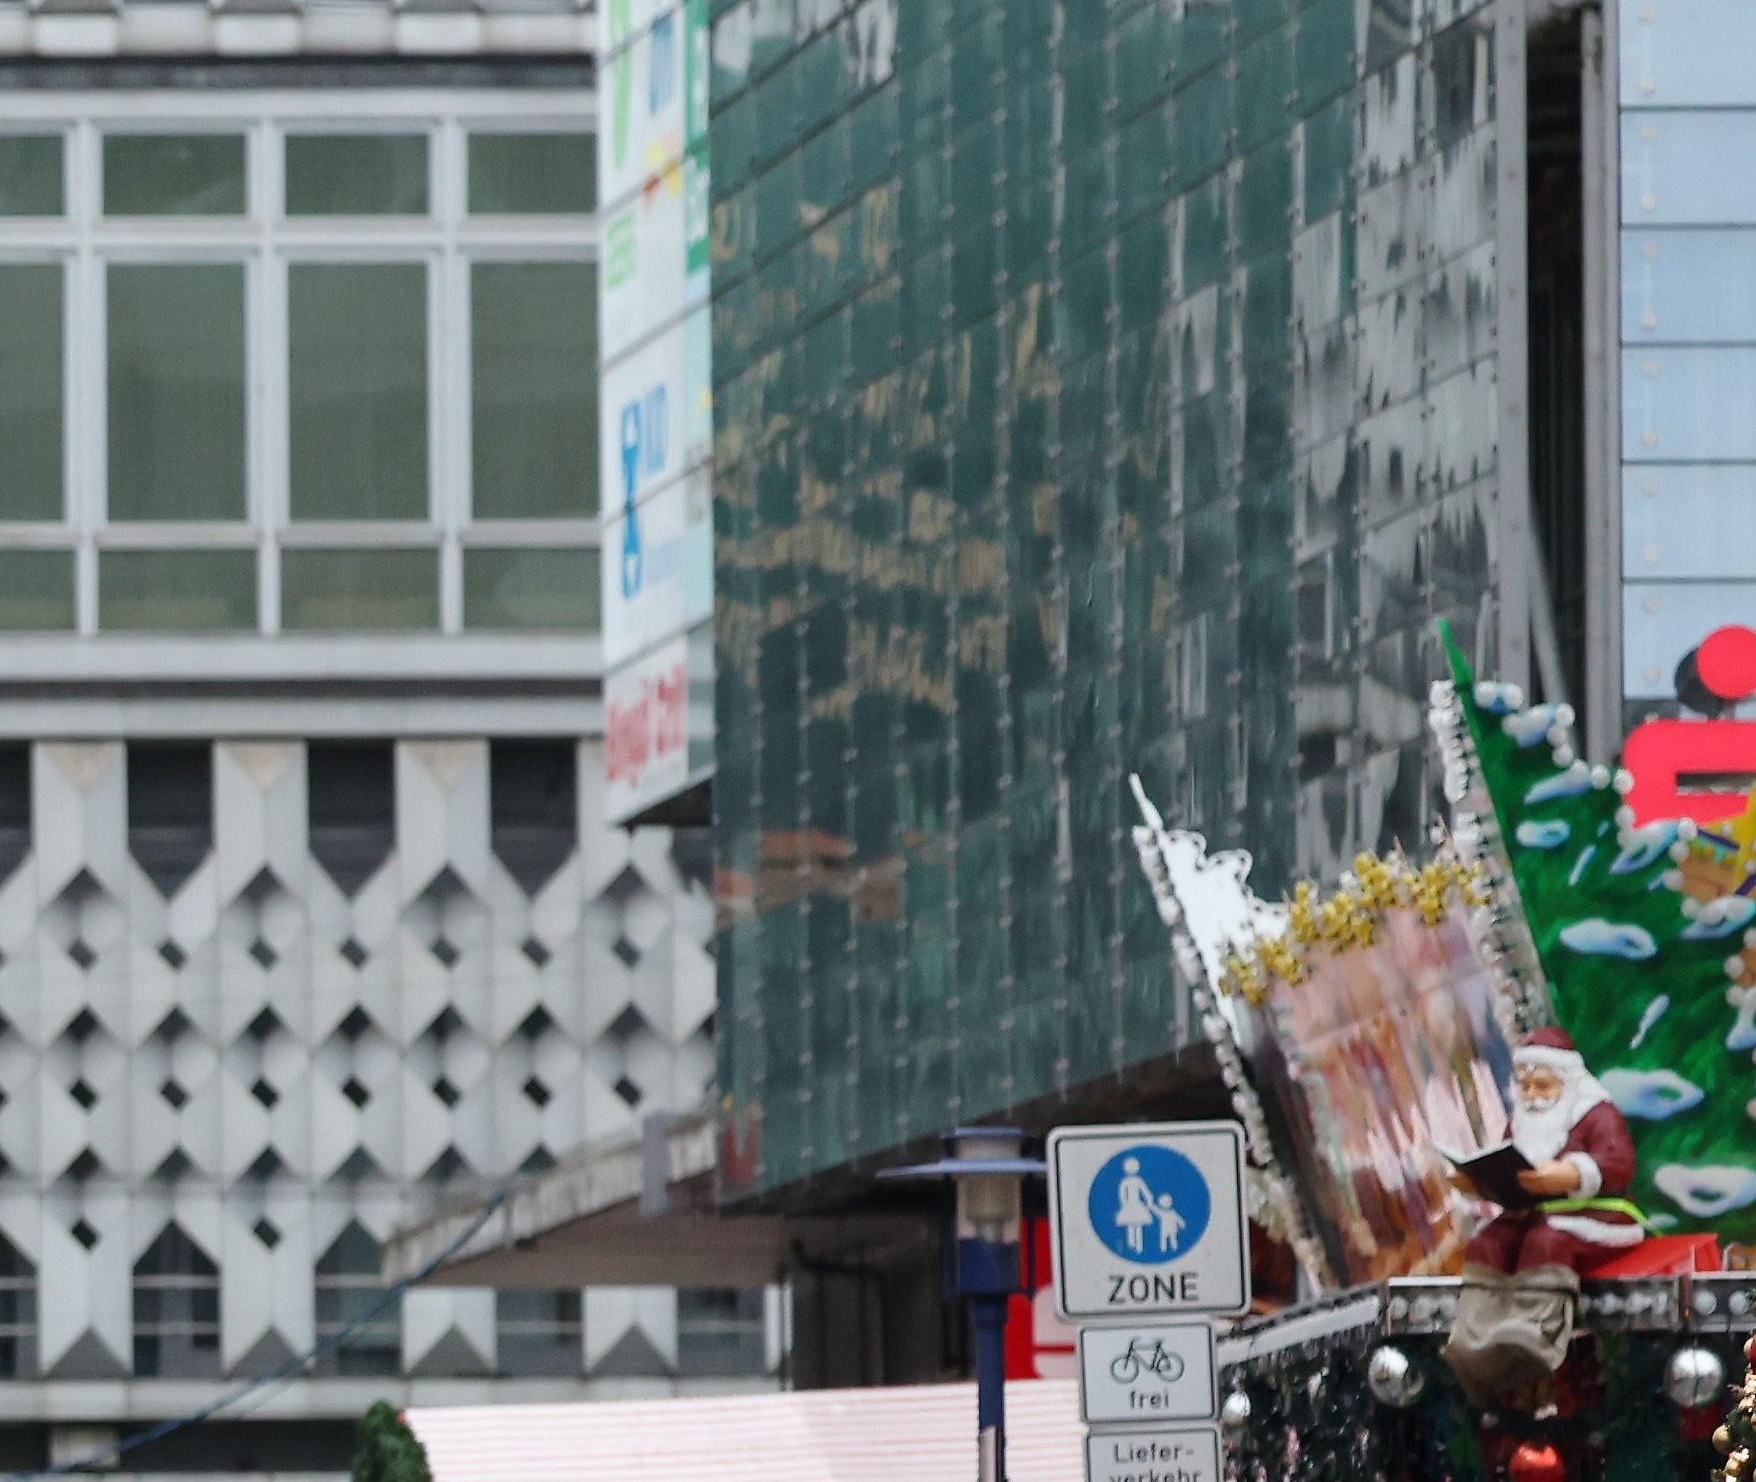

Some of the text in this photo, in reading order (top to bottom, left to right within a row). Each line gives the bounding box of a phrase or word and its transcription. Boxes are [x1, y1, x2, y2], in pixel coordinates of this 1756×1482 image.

[1107, 1272, 1200, 1304] ZONE
[1129, 1389, 1170, 1409] frei
[1113, 1443, 1195, 1463] Liefer-
